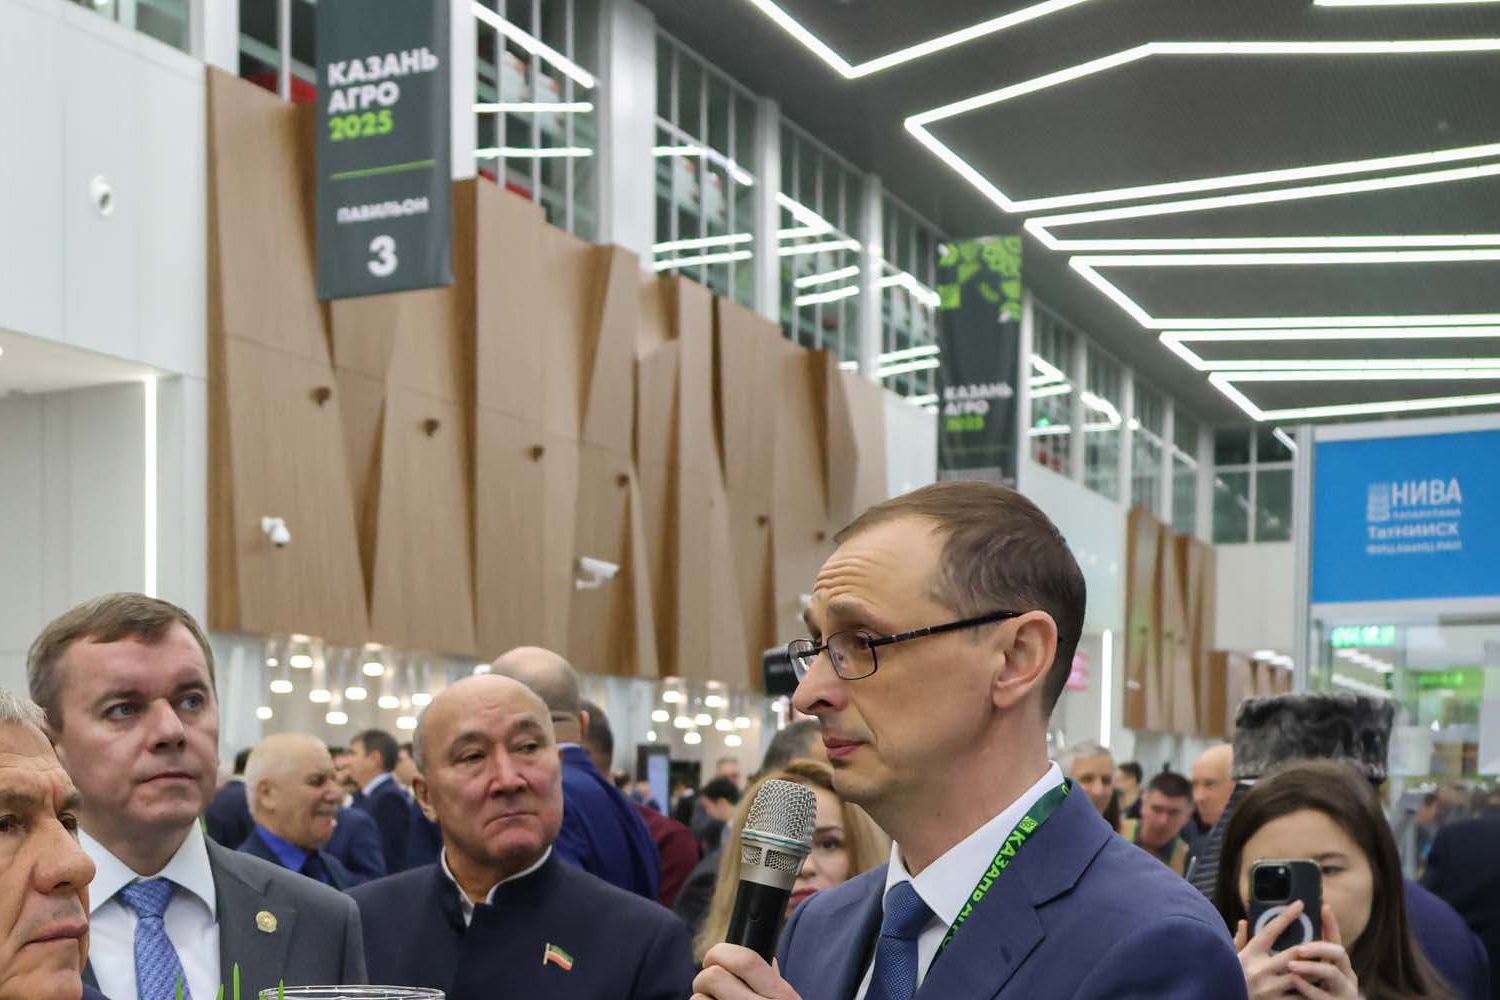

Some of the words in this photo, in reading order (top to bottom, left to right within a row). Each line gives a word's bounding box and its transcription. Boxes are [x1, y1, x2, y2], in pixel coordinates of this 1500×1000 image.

[328, 48, 438, 86] КАЗАНЬ
[328, 82, 400, 114] АГРО
[329, 110, 393, 141] 2025
[337, 198, 429, 223] ПАВИЛЬОН
[368, 235, 398, 277] 3
[1392, 478, 1462, 505] НИВА
